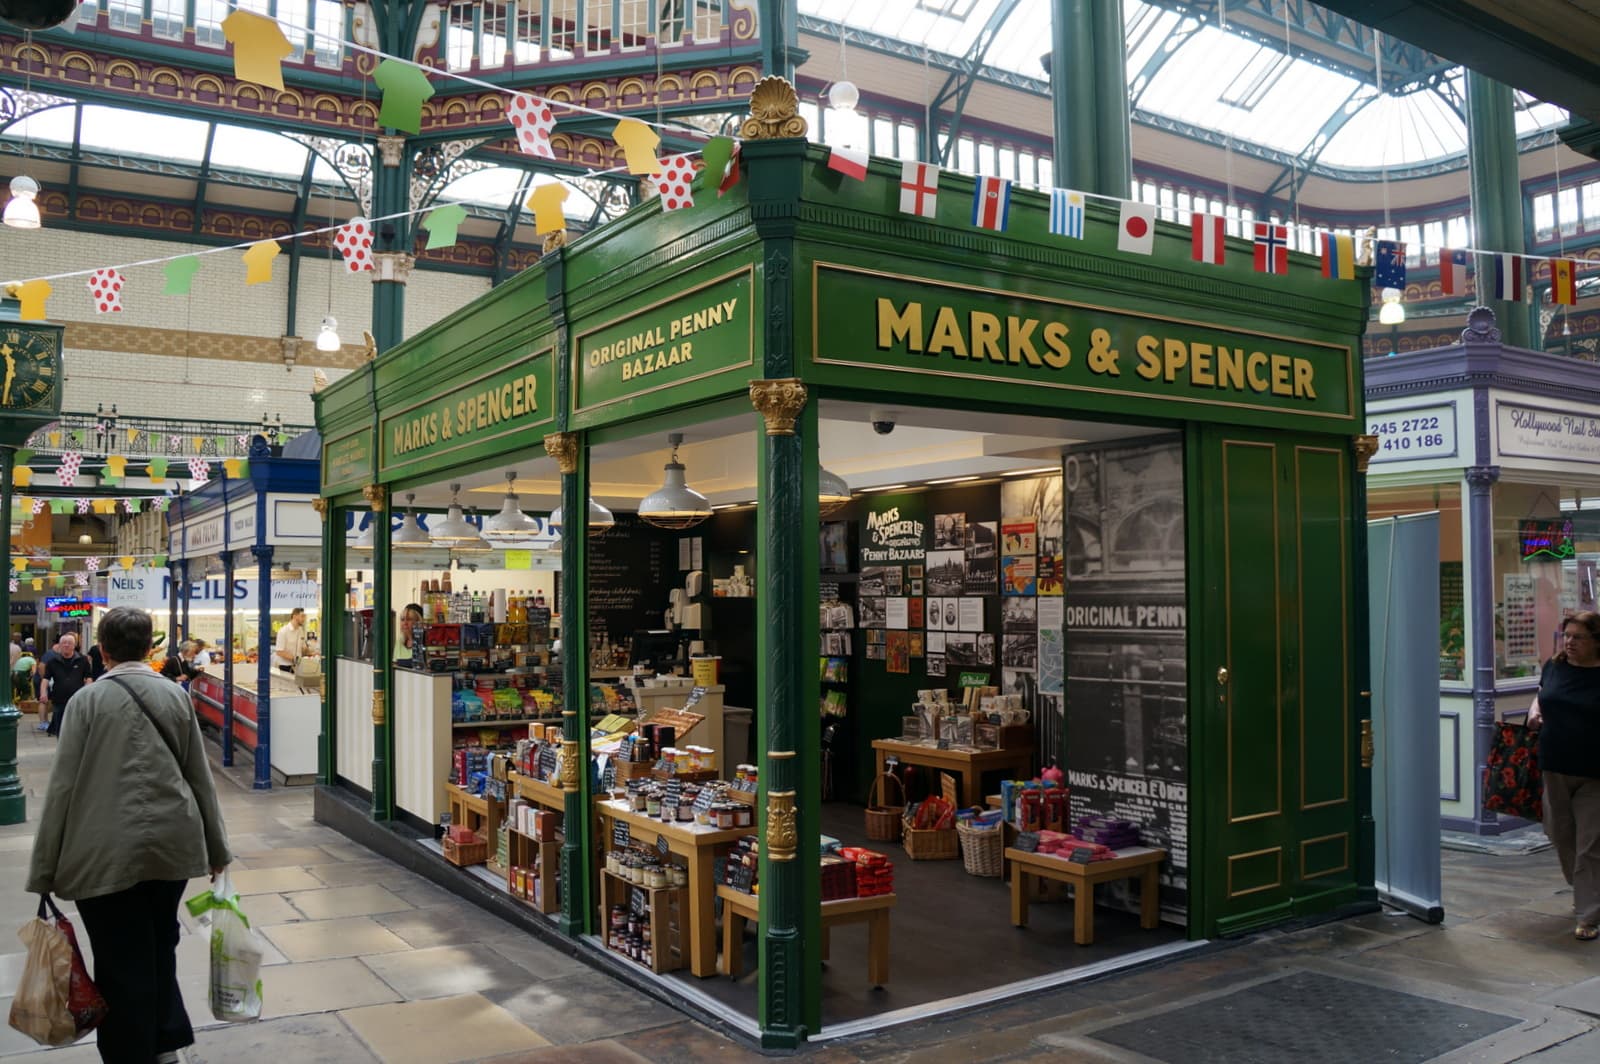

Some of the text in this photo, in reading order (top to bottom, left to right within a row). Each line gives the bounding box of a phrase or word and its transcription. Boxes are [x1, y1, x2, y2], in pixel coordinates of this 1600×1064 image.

[590, 298, 737, 368] ORIGINAL PENNY
[876, 297, 1317, 399] MARKS & SPENCER
[622, 342, 693, 382] BAZAAR
[393, 412, 438, 456] MARKS
[441, 407, 452, 440] &
[456, 374, 538, 435] SPENCER
[1371, 417, 1439, 435] 245 2722
[1510, 408, 1562, 437] Hollywood
[1563, 416, 1586, 436] Nail
[1384, 434, 1443, 451] 410 186
[866, 507, 900, 530] MARKS
[111, 577, 144, 590] NEIL'S
[162, 574, 249, 600] NEILS
[1067, 606, 1132, 627] ORIGINAL
[1068, 769, 1098, 789] MARKS
